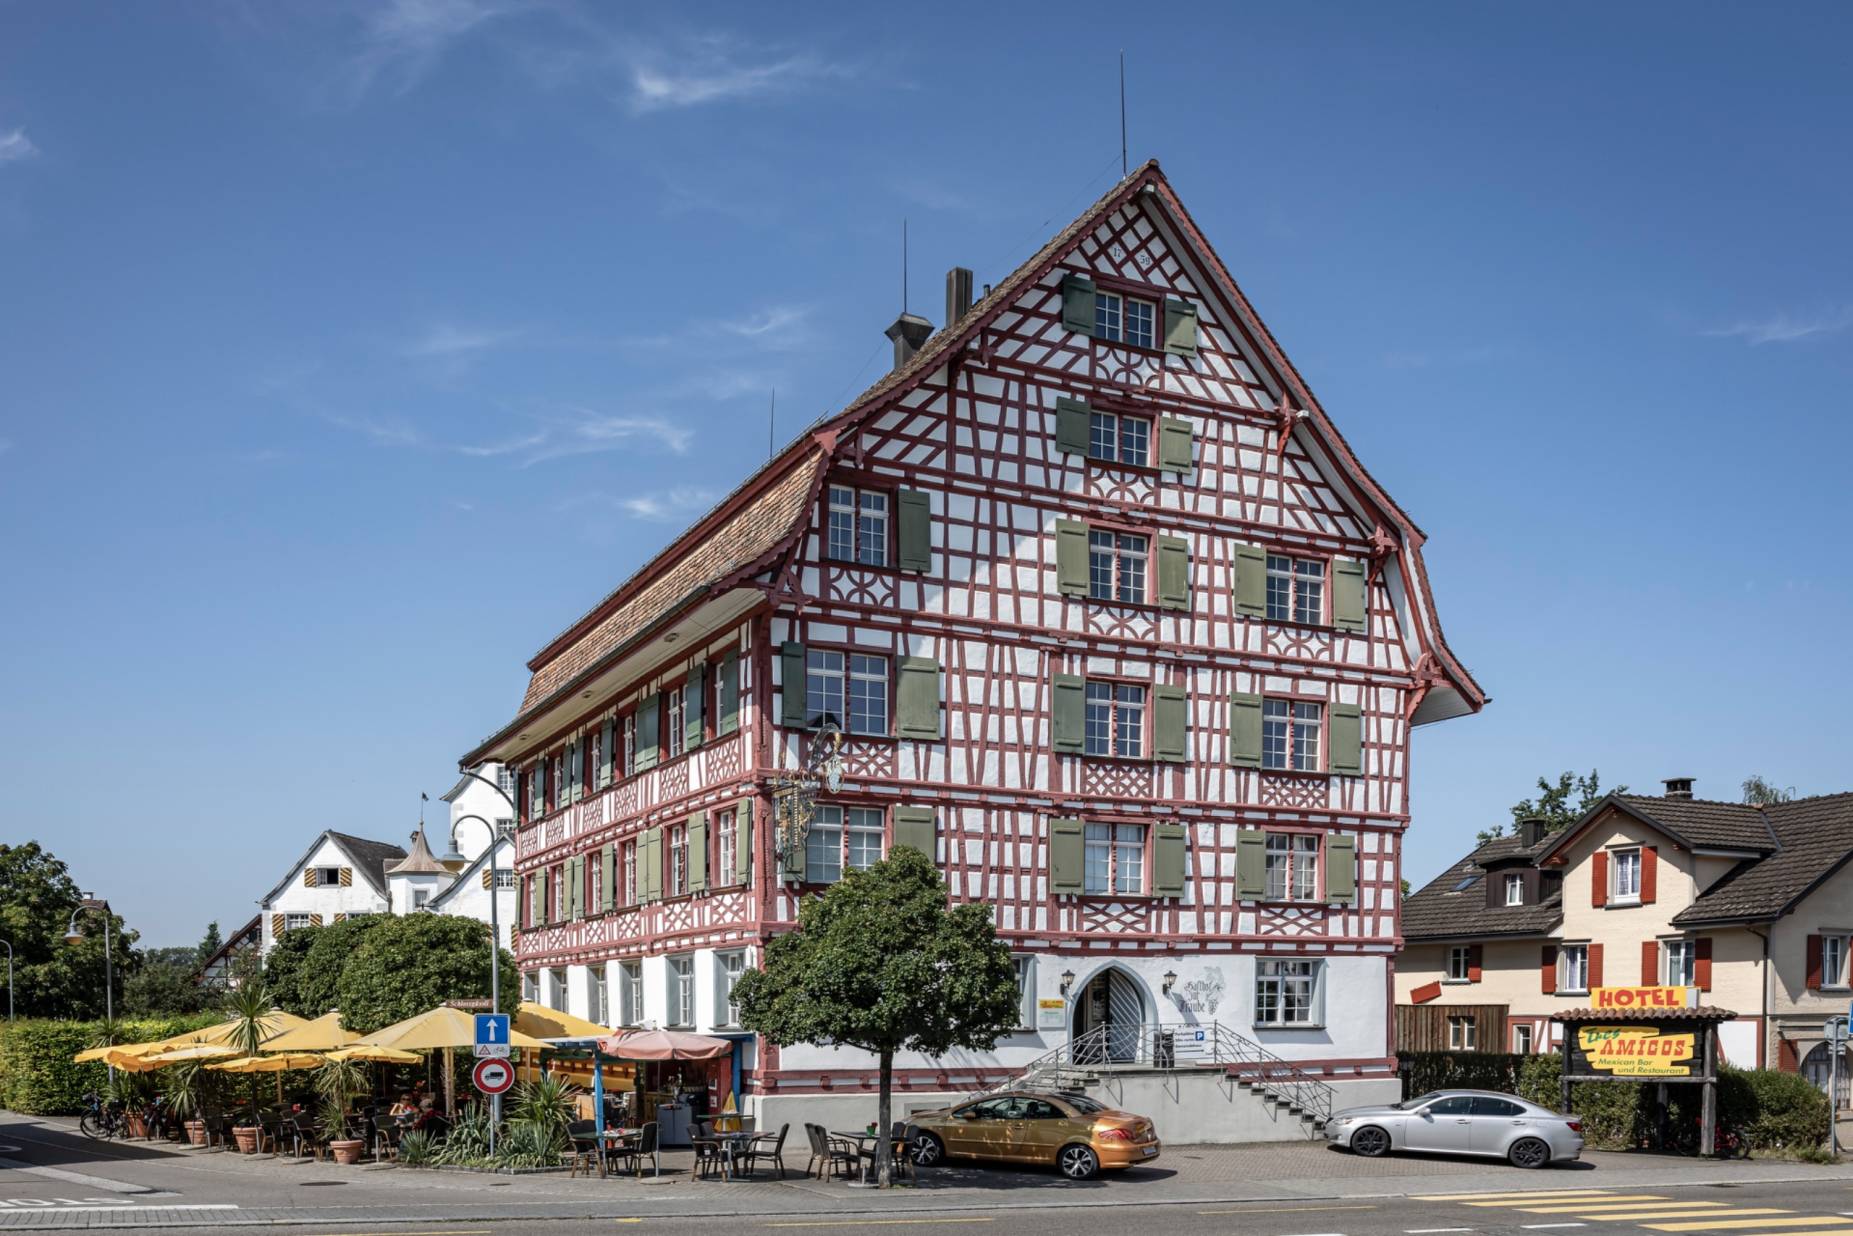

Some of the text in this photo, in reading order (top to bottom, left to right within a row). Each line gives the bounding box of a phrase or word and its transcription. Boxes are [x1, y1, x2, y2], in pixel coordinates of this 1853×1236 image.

[1599, 989, 1679, 1007] HOTEL
[1585, 1028, 1620, 1043] Tres
[1600, 1040, 1685, 1056] AMIGOS
[1598, 1058, 1634, 1066] Mexican
